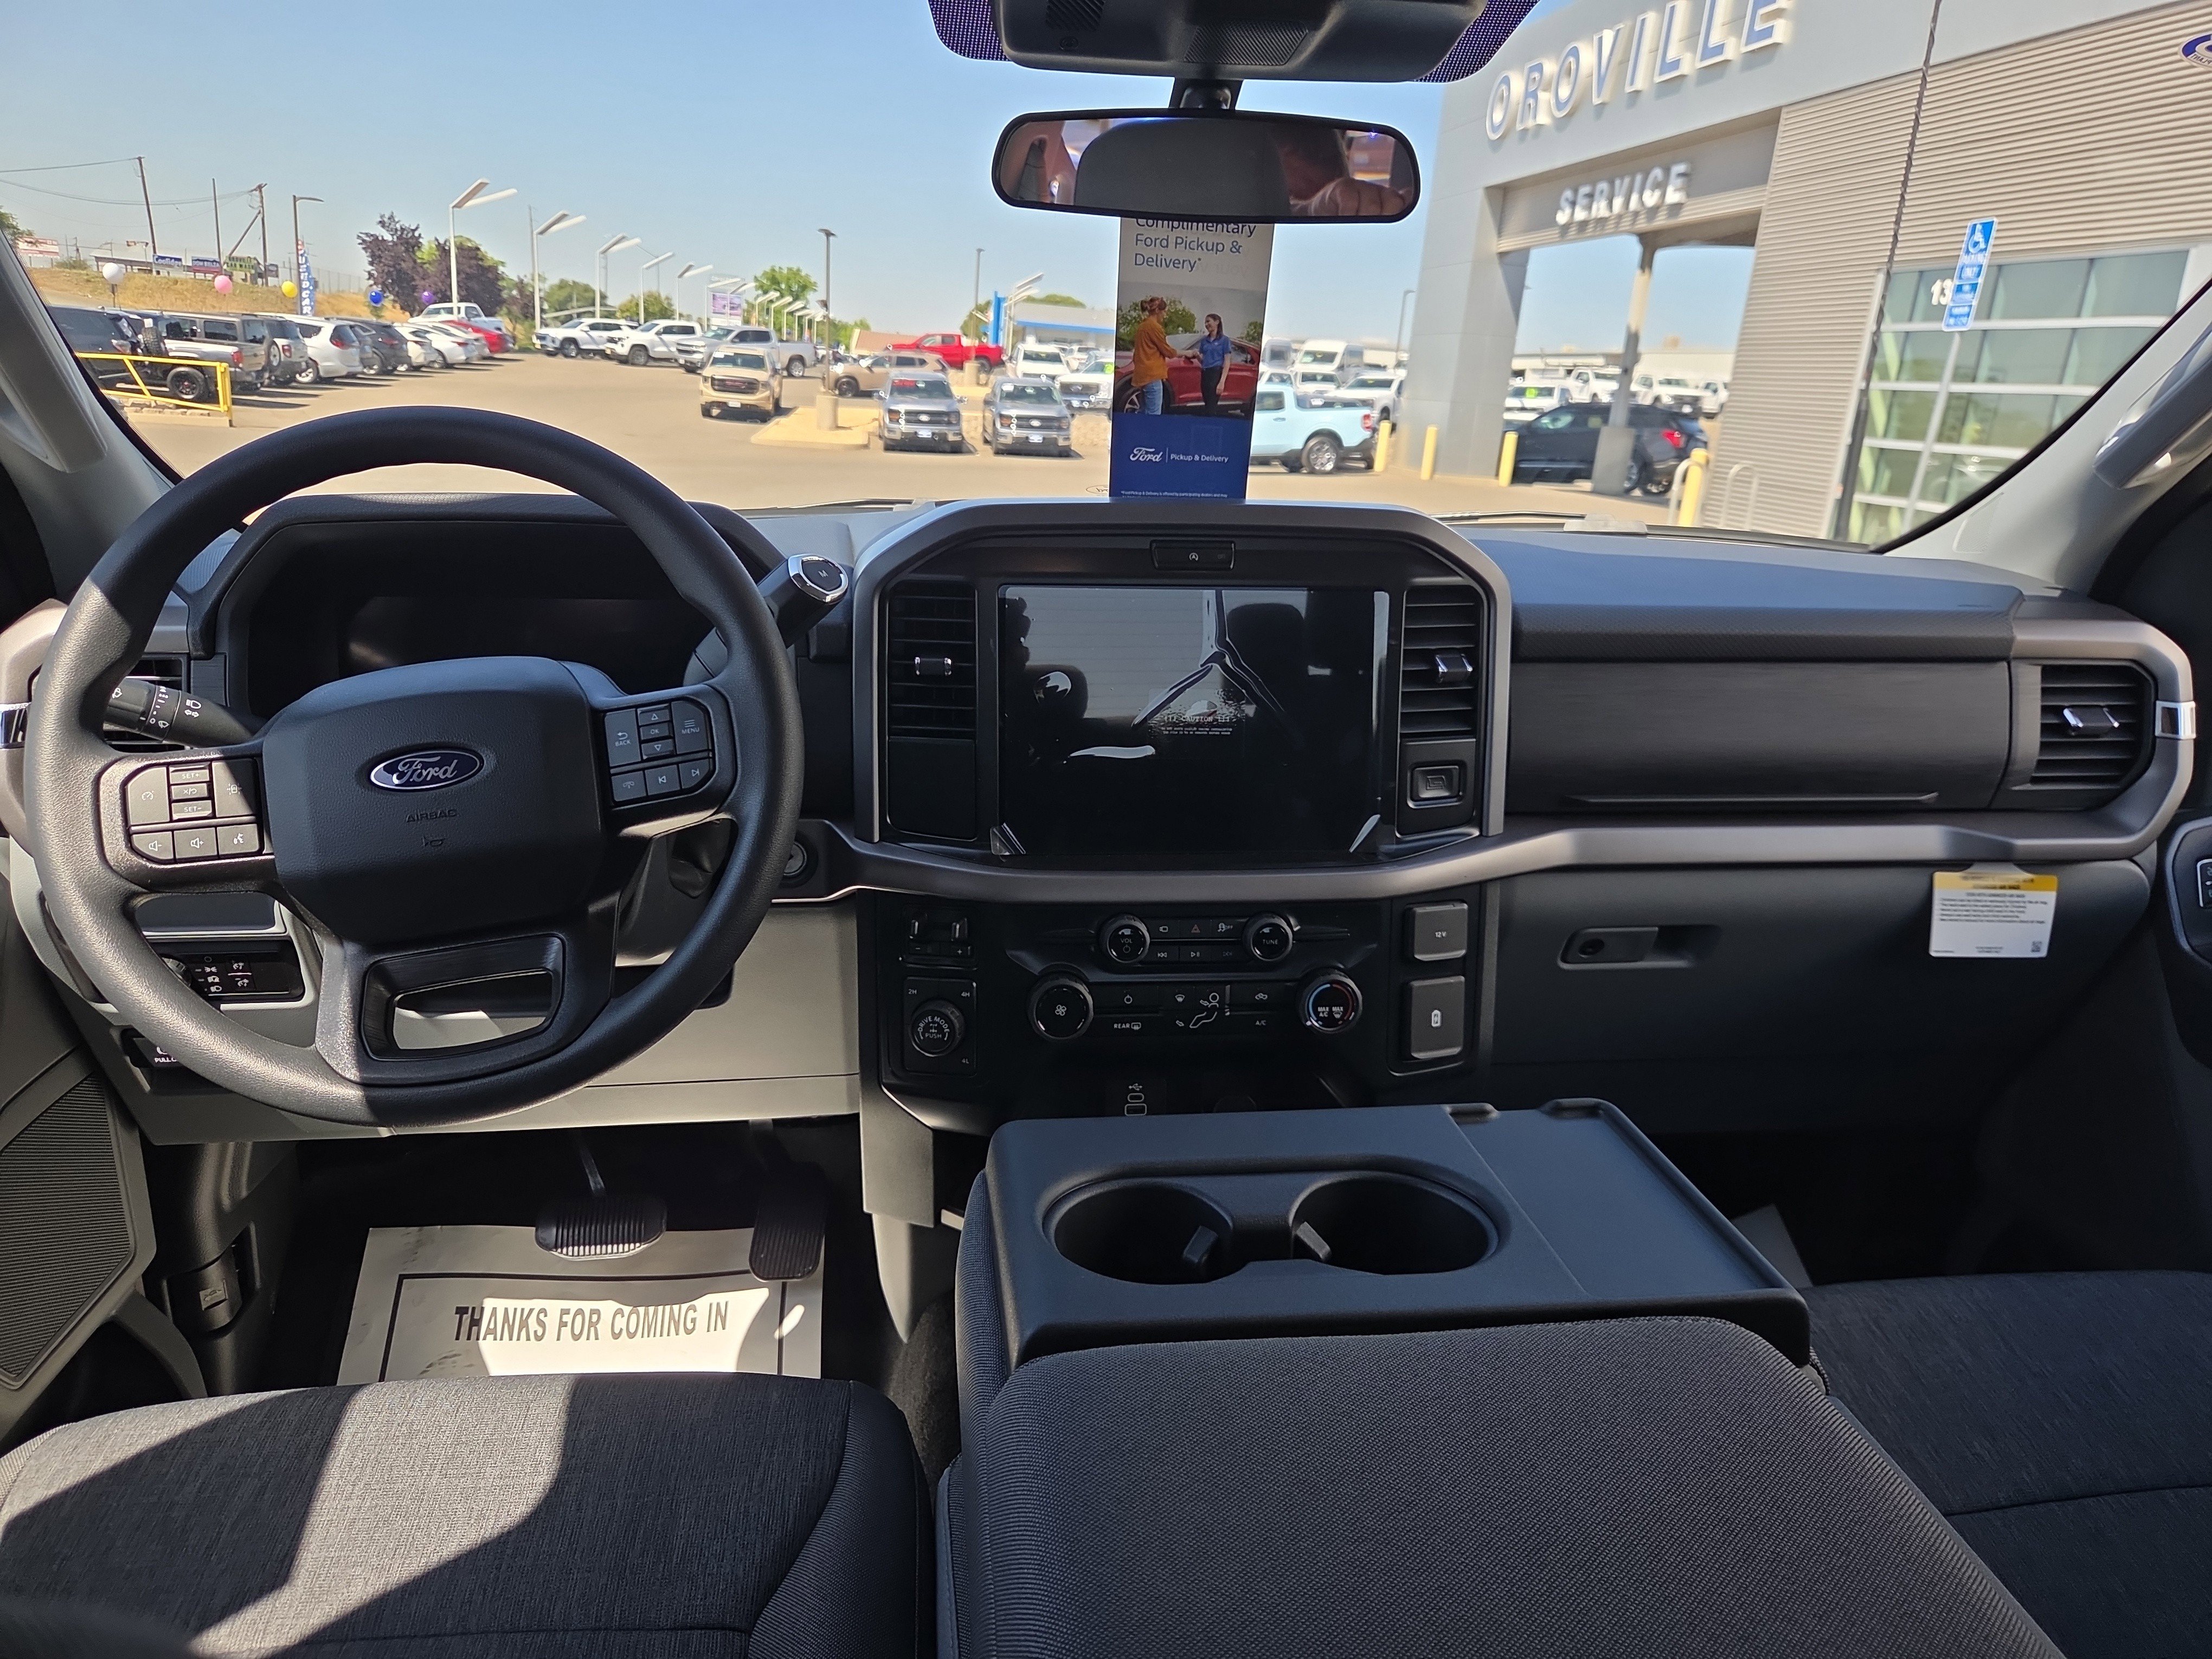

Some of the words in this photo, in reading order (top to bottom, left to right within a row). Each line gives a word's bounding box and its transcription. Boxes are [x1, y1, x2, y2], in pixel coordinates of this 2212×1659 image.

[1486, 0, 1791, 140] OROVILLE
[1556, 162, 1692, 226] SERVICE
[1136, 218, 1256, 237] Complimentary
[1135, 233, 1169, 249] Ford
[1174, 235, 1225, 255] Pickup
[1230, 240, 1242, 254] &
[1129, 447, 1163, 462] Ford
[1171, 453, 1193, 462] Pickup
[1201, 454, 1229, 463] Delivery
[392, 756, 458, 785] Ford
[917, 1015, 933, 1032] DRIVE
[934, 1015, 950, 1033] MODE
[454, 1306, 547, 1342] THANKS
[556, 1307, 601, 1341] FOR
[610, 1303, 698, 1340] COMING
[706, 1301, 729, 1333] IN
